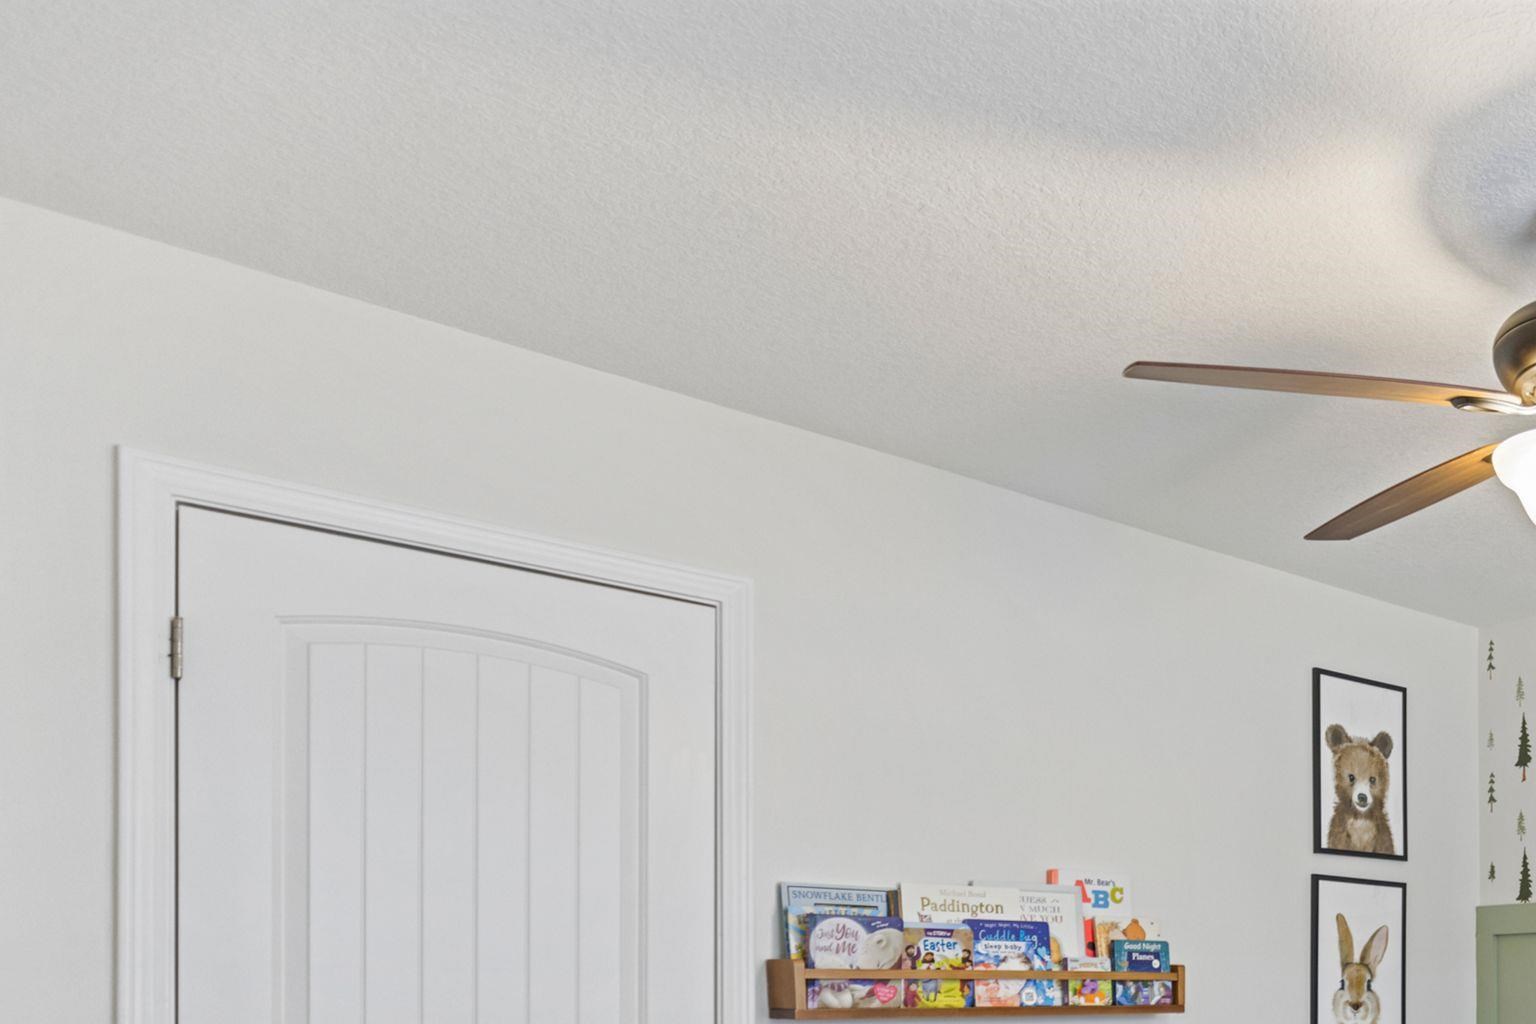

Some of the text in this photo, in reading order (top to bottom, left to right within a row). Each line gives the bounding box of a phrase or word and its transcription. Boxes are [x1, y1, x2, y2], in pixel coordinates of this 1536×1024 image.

[792, 890, 886, 903] SNOWFLAKE BENTL
[1075, 880, 1124, 909] ABC
[920, 897, 1004, 917] Paddington
[835, 923, 859, 941] You
[979, 929, 1016, 941] Cuddle
[923, 939, 957, 952] Easter
